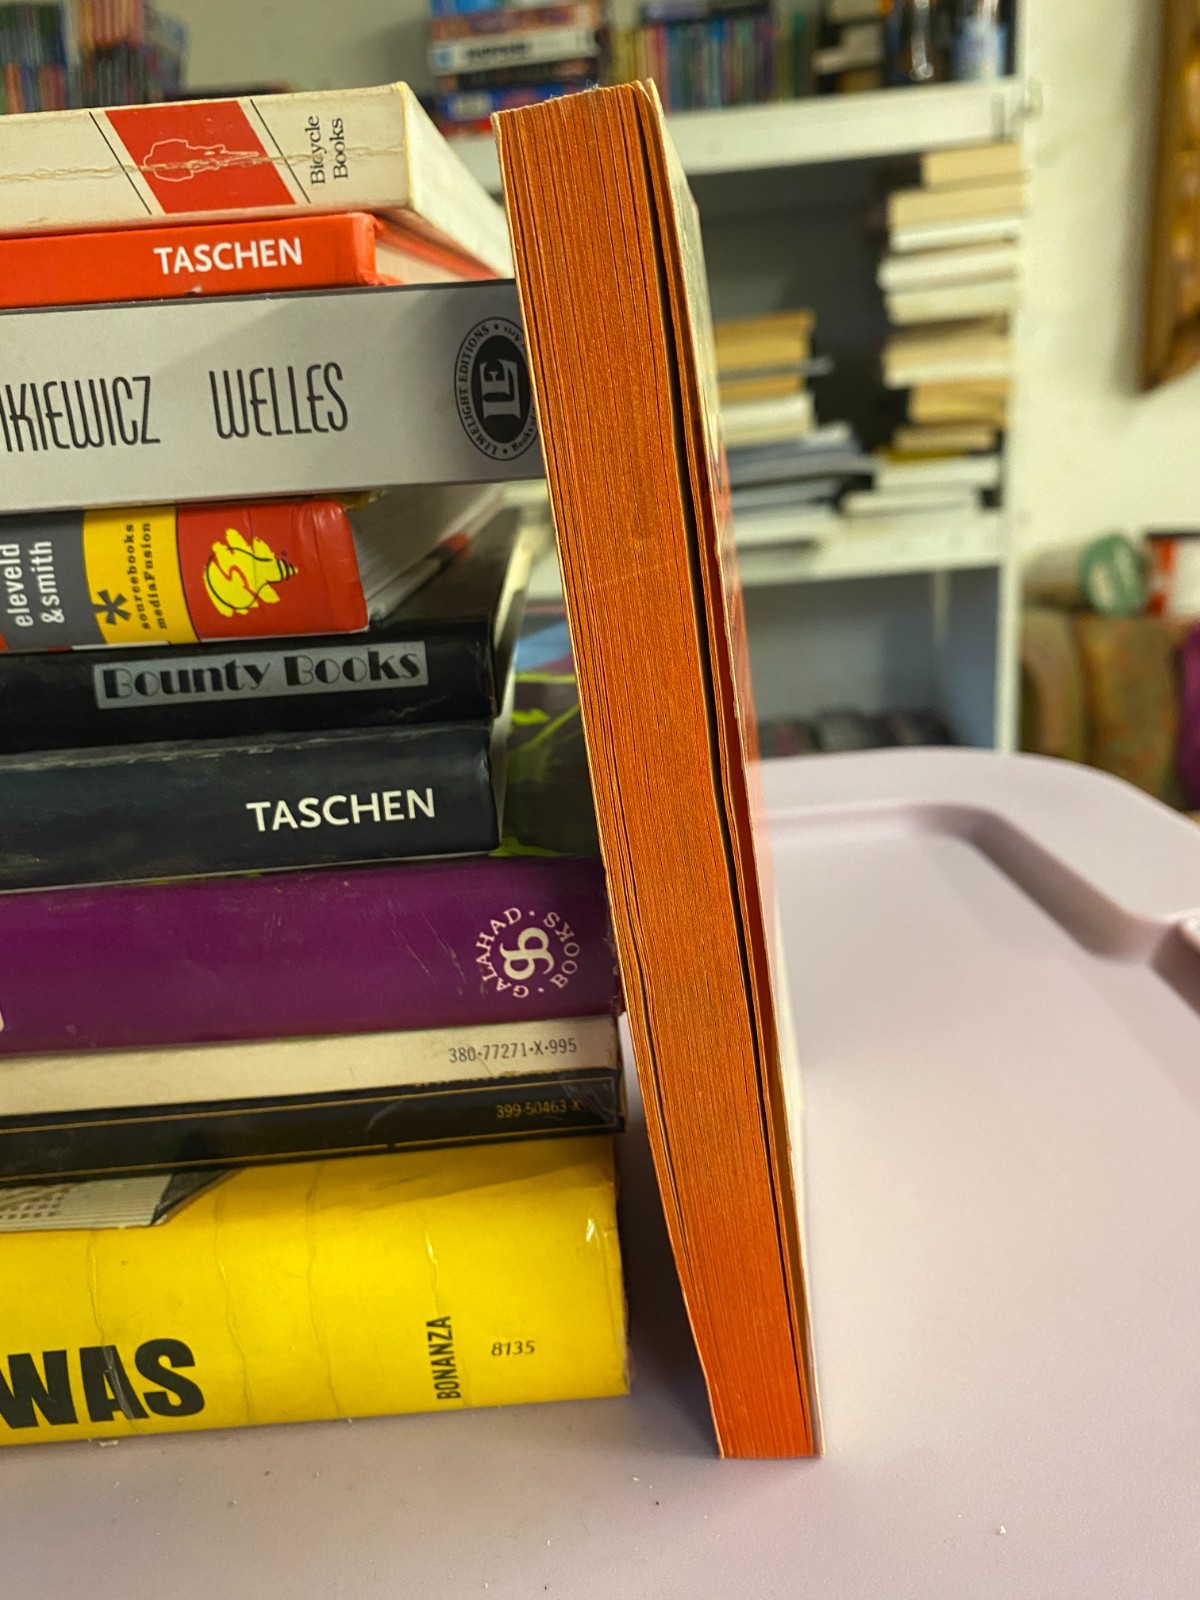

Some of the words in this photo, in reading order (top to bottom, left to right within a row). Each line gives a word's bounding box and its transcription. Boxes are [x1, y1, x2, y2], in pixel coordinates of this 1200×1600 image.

[305, 115, 327, 184] Bicycle
[330, 117, 348, 179] Books
[153, 237, 303, 275] TASCHEN
[458, 324, 490, 383] EDITIONS
[0, 375, 161, 452] KIEWICZ
[208, 361, 349, 439] WELLES
[458, 388, 498, 455] LIMELIGHT
[125, 524, 151, 629] sourcebooks
[141, 523, 167, 629] mediaFusion
[103, 659, 270, 699] Bounty
[284, 650, 421, 686] Books
[246, 788, 435, 832] TASCHEN
[475, 907, 530, 998] GALAHAD
[542, 911, 580, 988] BOOKS
[426, 1315, 462, 1400] BONANZA
[491, 1340, 535, 1356] 8135
[0, 1338, 206, 1430] WAS
